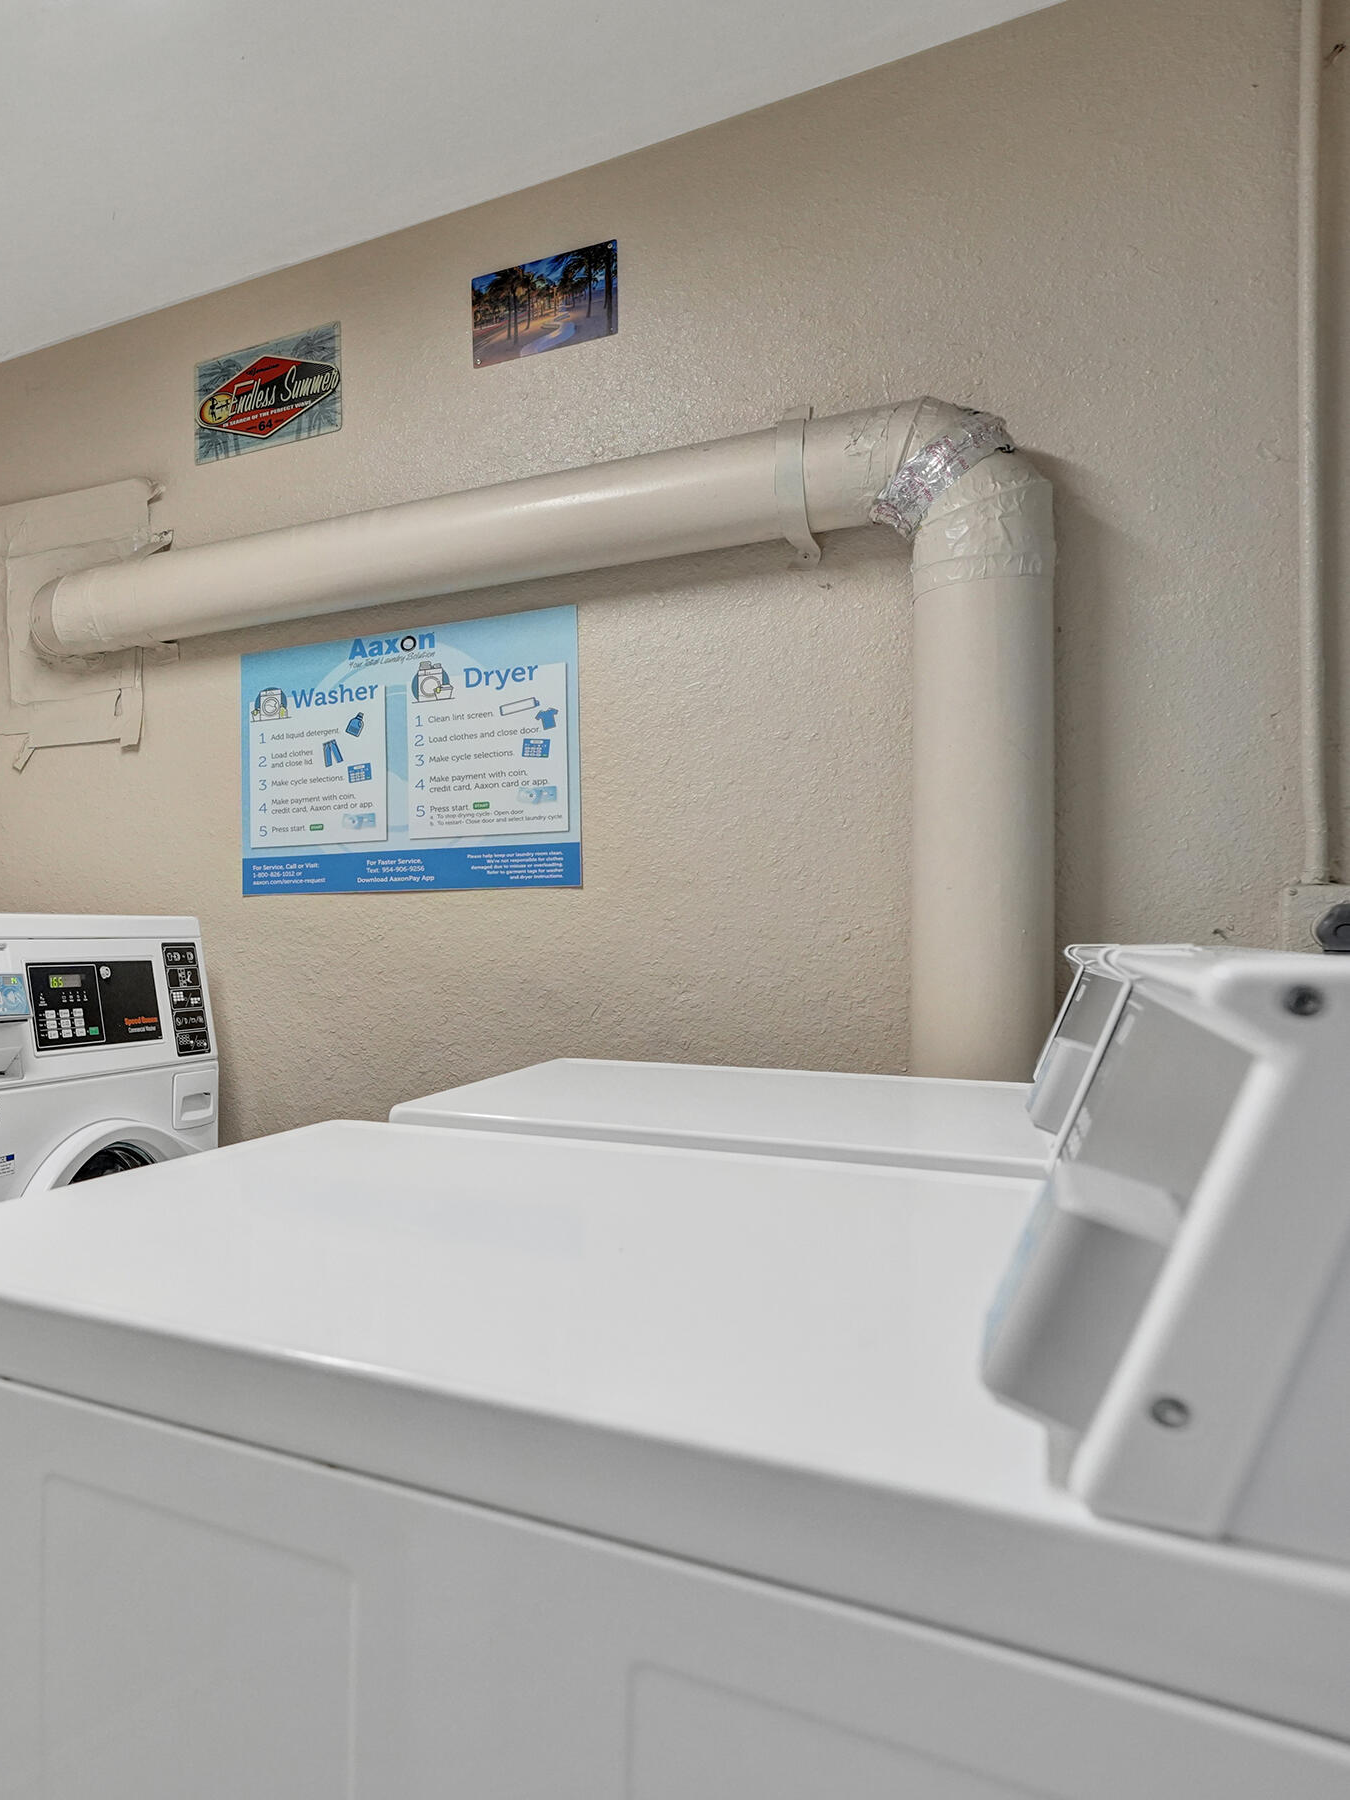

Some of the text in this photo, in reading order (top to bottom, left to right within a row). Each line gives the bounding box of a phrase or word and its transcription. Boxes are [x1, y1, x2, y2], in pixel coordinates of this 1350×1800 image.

[228, 365, 339, 417] Endless Summer
[270, 405, 294, 414] PERFECT
[258, 419, 273, 431] 64
[349, 633, 435, 660] Aaxon
[463, 665, 539, 691] Dryer
[291, 684, 378, 709] Washer
[415, 715, 423, 727] 1
[428, 714, 450, 724] Clean
[452, 713, 465, 721] lint
[259, 733, 266, 744] 1
[414, 734, 425, 747] 2
[428, 734, 447, 743] Load
[449, 732, 478, 742] clothes
[479, 730, 495, 738] and
[497, 727, 518, 737] close
[258, 756, 267, 767] 2
[271, 751, 288, 759] Load
[415, 754, 425, 767] 3
[428, 755, 449, 763] Make
[451, 753, 471, 763] cycle
[258, 780, 267, 791] 3
[290, 778, 308, 787] cycle
[415, 779, 425, 790] 4
[429, 775, 449, 783] Make
[451, 771, 486, 783] payment
[488, 770, 506, 778] with
[429, 785, 451, 793] credit
[474, 782, 500, 790] Aaxon
[501, 780, 519, 789] card
[258, 803, 267, 813] 4
[290, 795, 321, 805] payment
[322, 793, 338, 801] with
[415, 805, 426, 818] 5
[430, 805, 450, 813] Press
[259, 825, 268, 837] 5
